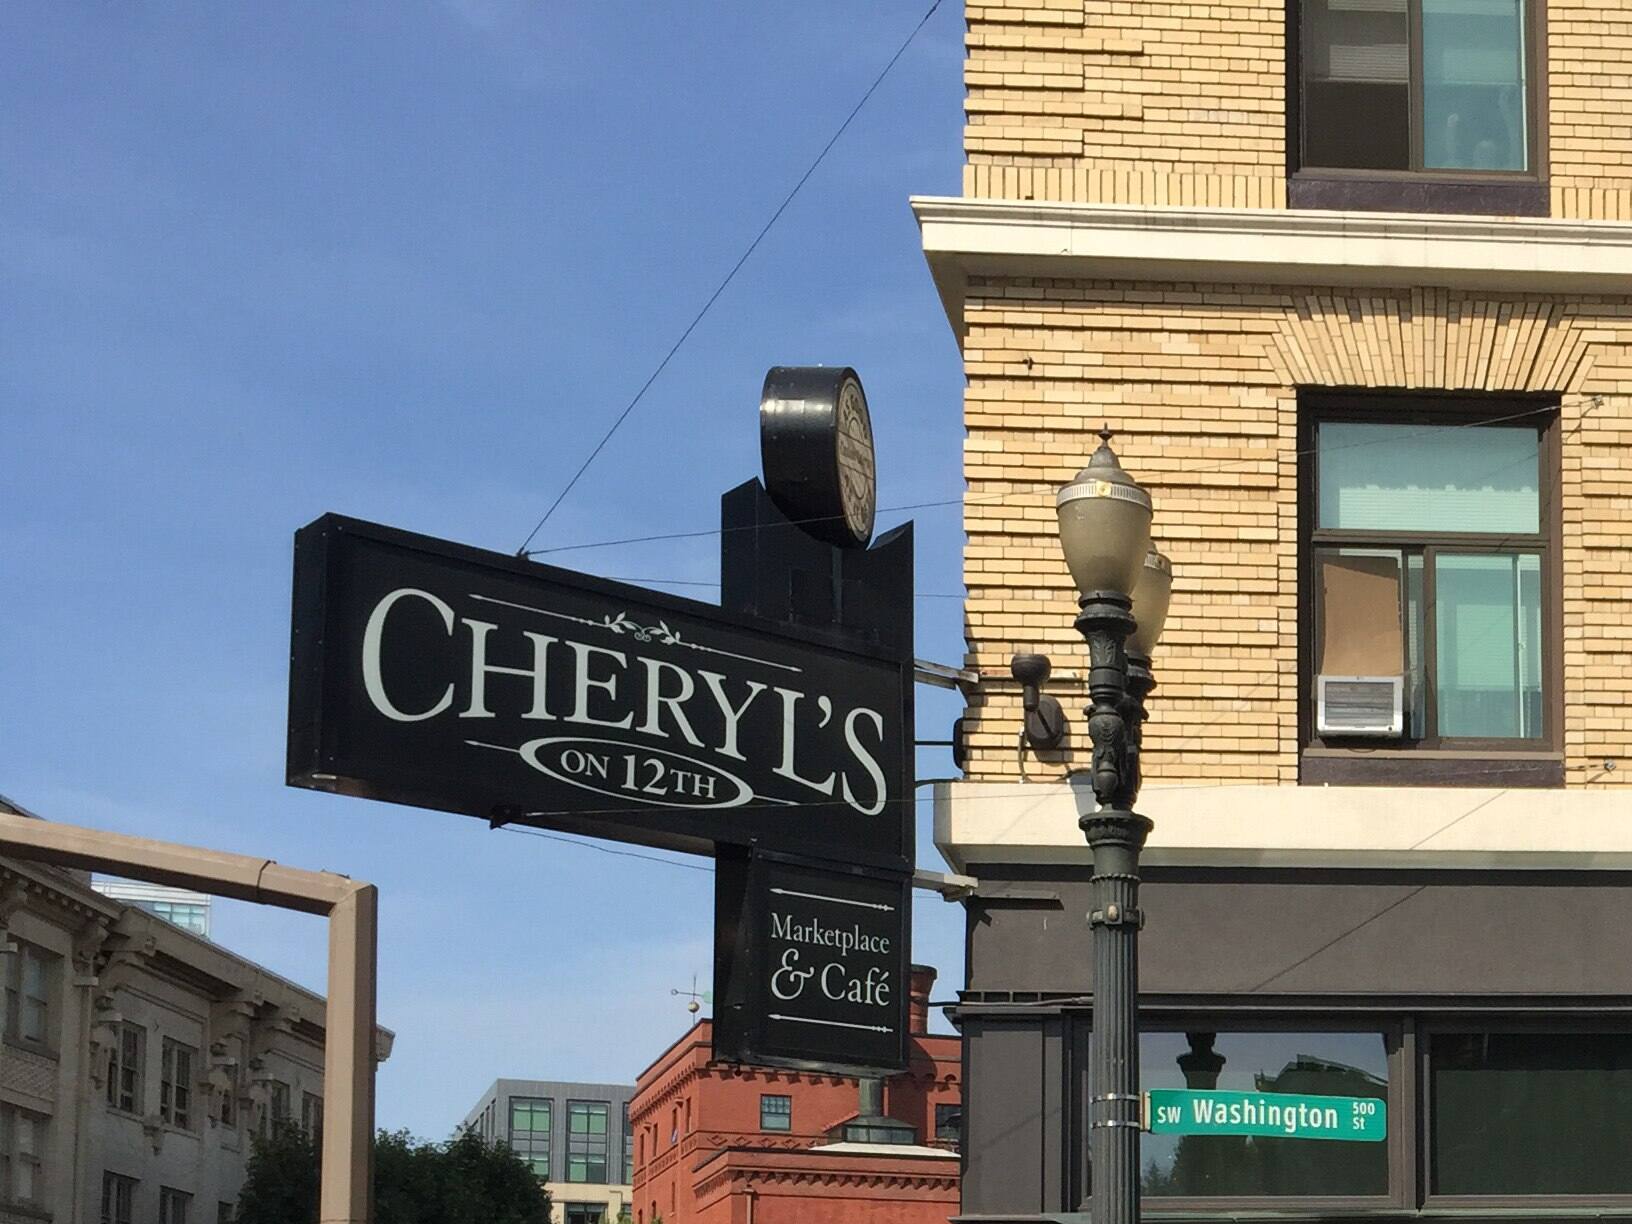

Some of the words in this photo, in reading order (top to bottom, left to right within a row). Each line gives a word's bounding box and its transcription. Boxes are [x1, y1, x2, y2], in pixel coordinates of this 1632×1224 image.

[362, 587, 887, 816] CHERYL'S
[561, 748, 609, 779] ON
[623, 752, 716, 799] 12TH
[770, 911, 891, 955] Marketplace
[770, 947, 814, 999] &
[821, 961, 891, 1007] Café
[1157, 1105, 1181, 1124] SW
[1193, 1098, 1338, 1133] Washington
[1352, 1101, 1375, 1116] 500
[1352, 1115, 1365, 1130] St
